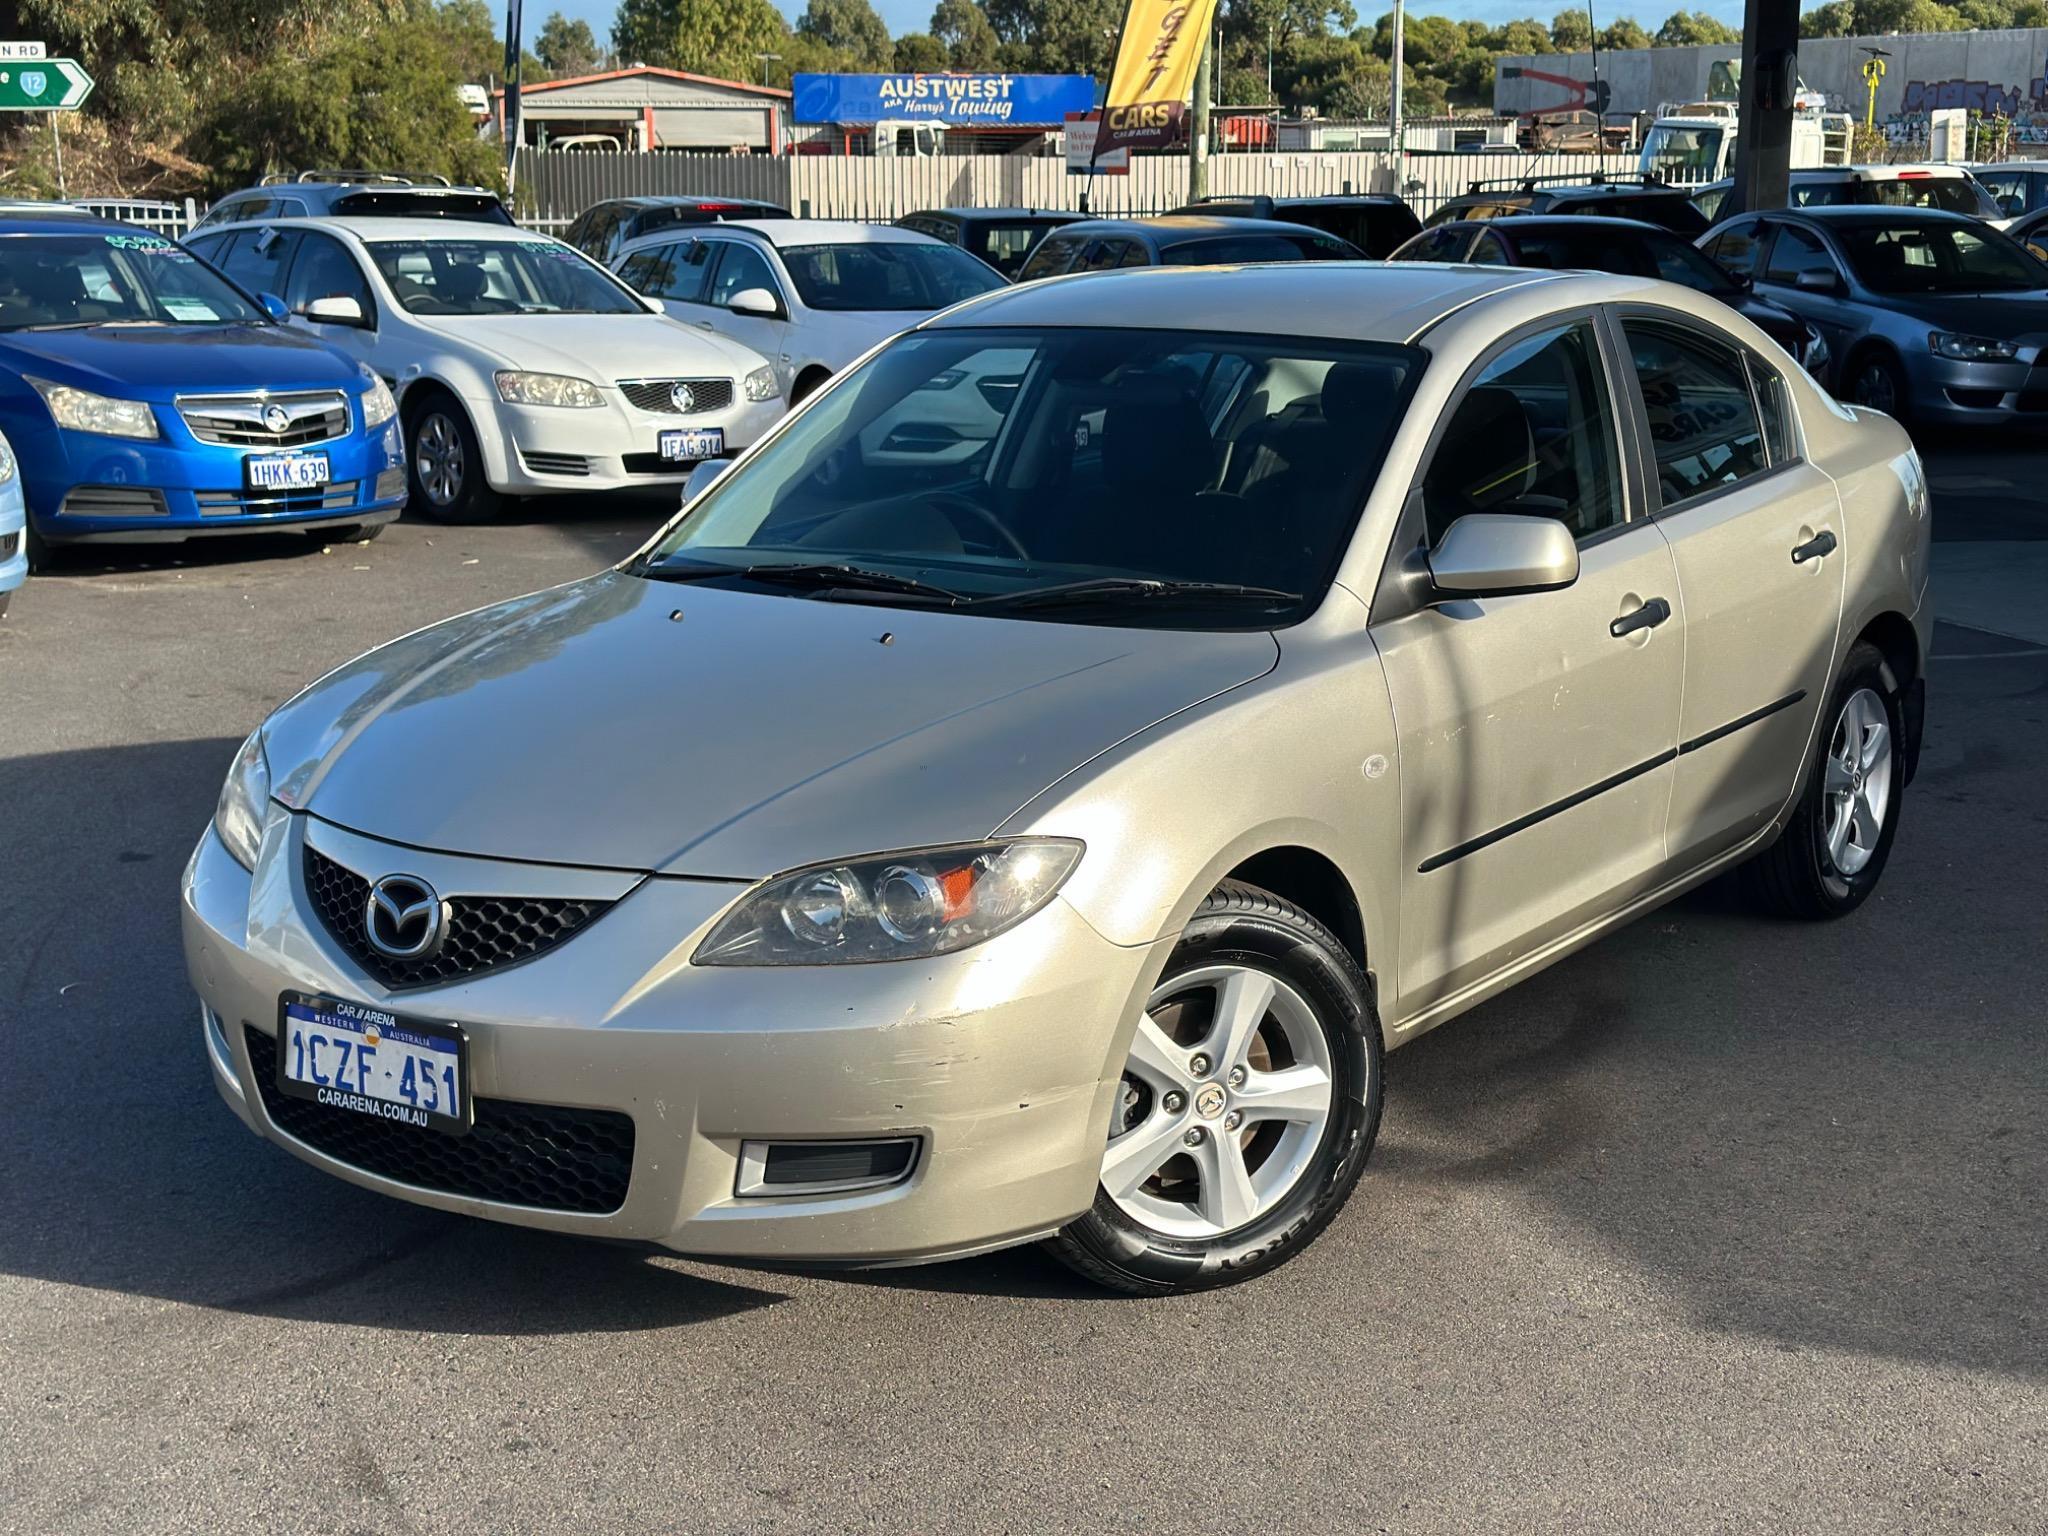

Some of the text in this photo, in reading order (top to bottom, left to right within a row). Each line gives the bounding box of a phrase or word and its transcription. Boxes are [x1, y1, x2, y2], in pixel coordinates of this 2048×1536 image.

[19, 45, 39, 56] RD
[27, 75, 41, 90] 12
[879, 79, 1014, 98] AUSTWEST
[884, 98, 903, 109] AKA
[904, 99, 945, 115] Harry's
[950, 96, 1013, 119] Towing
[1109, 104, 1170, 130] CARS
[664, 437, 721, 457] 1EAG 914
[254, 461, 327, 484] 1HKK 639
[314, 1014, 431, 1047] WESTERN AUSTRALIA
[293, 1029, 458, 1117] 1CZF 451
[317, 1087, 428, 1127] CARARENA.COM.AU
